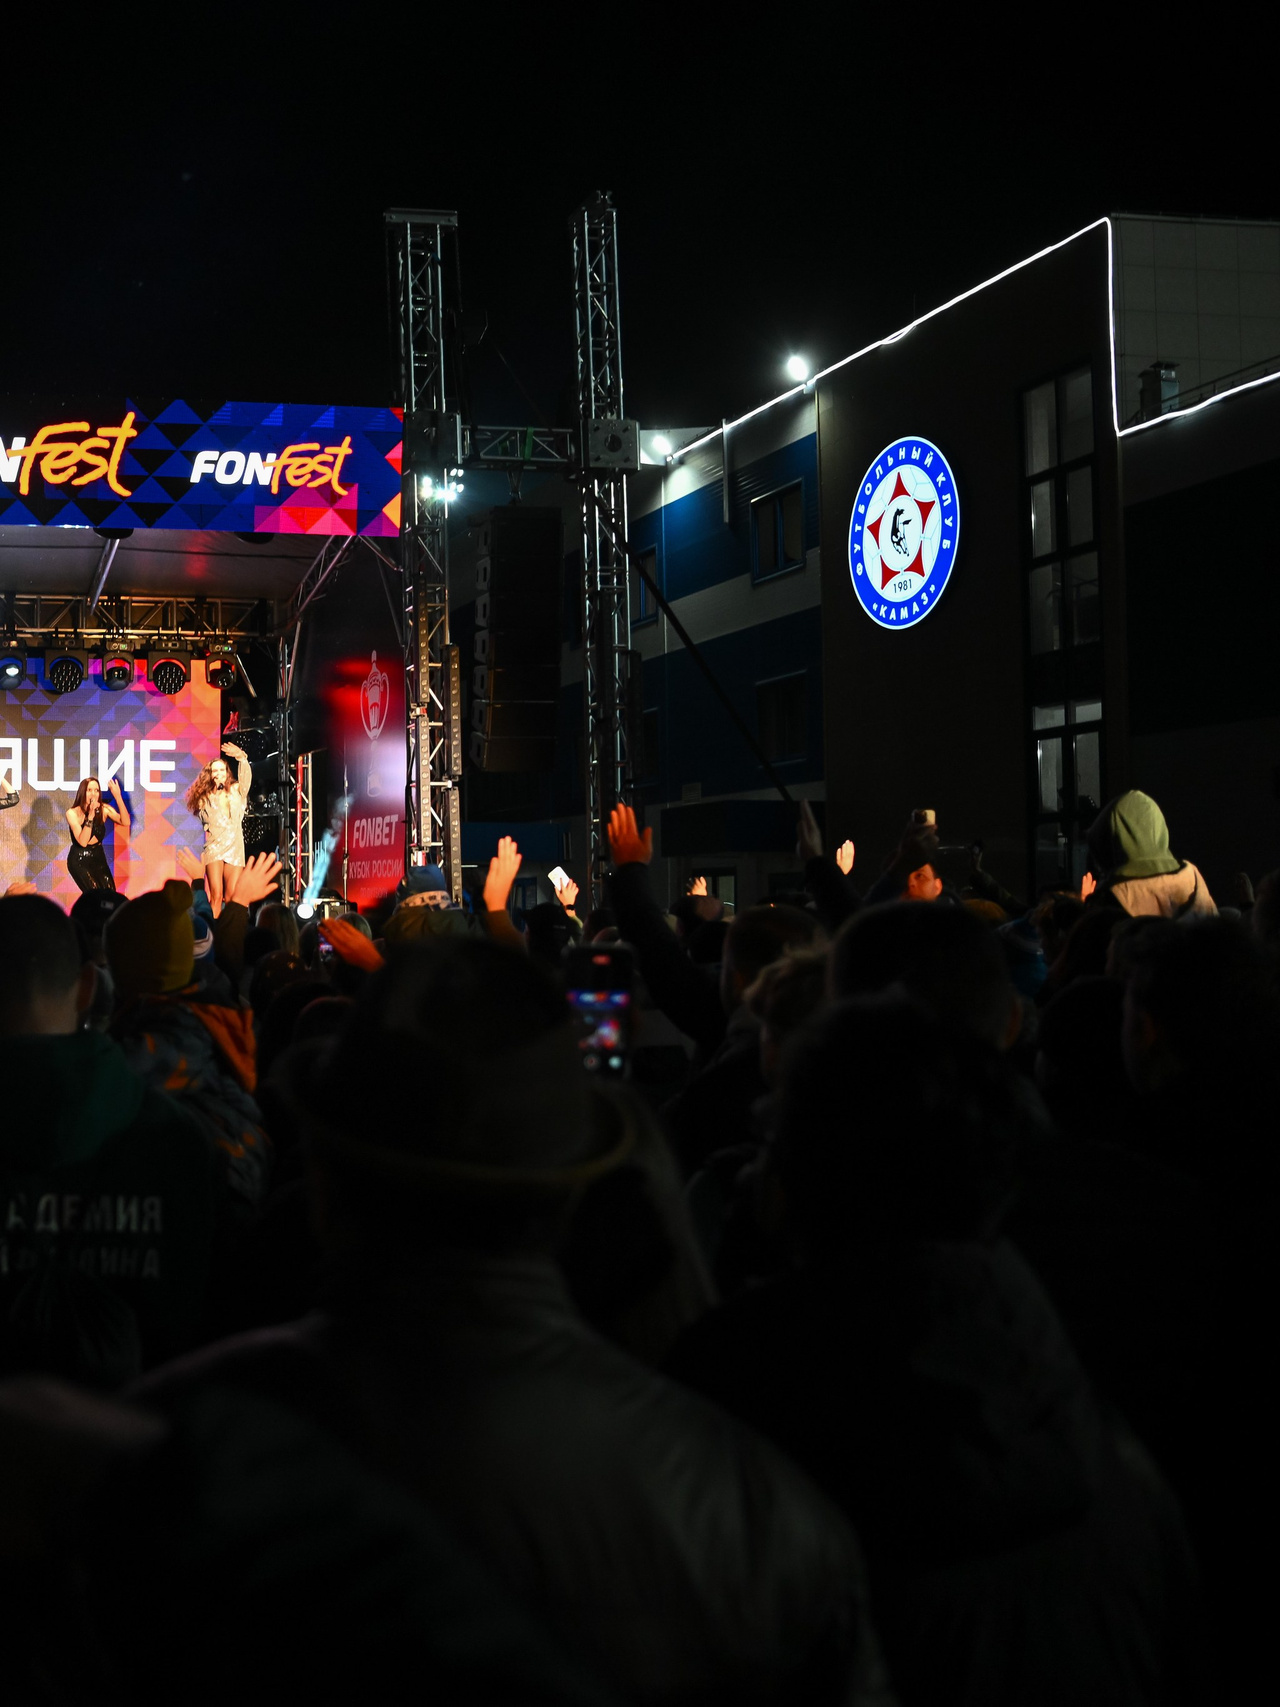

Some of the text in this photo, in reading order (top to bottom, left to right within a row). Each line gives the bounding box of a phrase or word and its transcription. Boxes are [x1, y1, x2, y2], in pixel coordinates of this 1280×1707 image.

[936, 472, 954, 550] КЛУБ
[893, 579, 913, 594] 1981
[352, 814, 399, 848] FONBET
[349, 859, 403, 879] КУБОК РОССИИ
